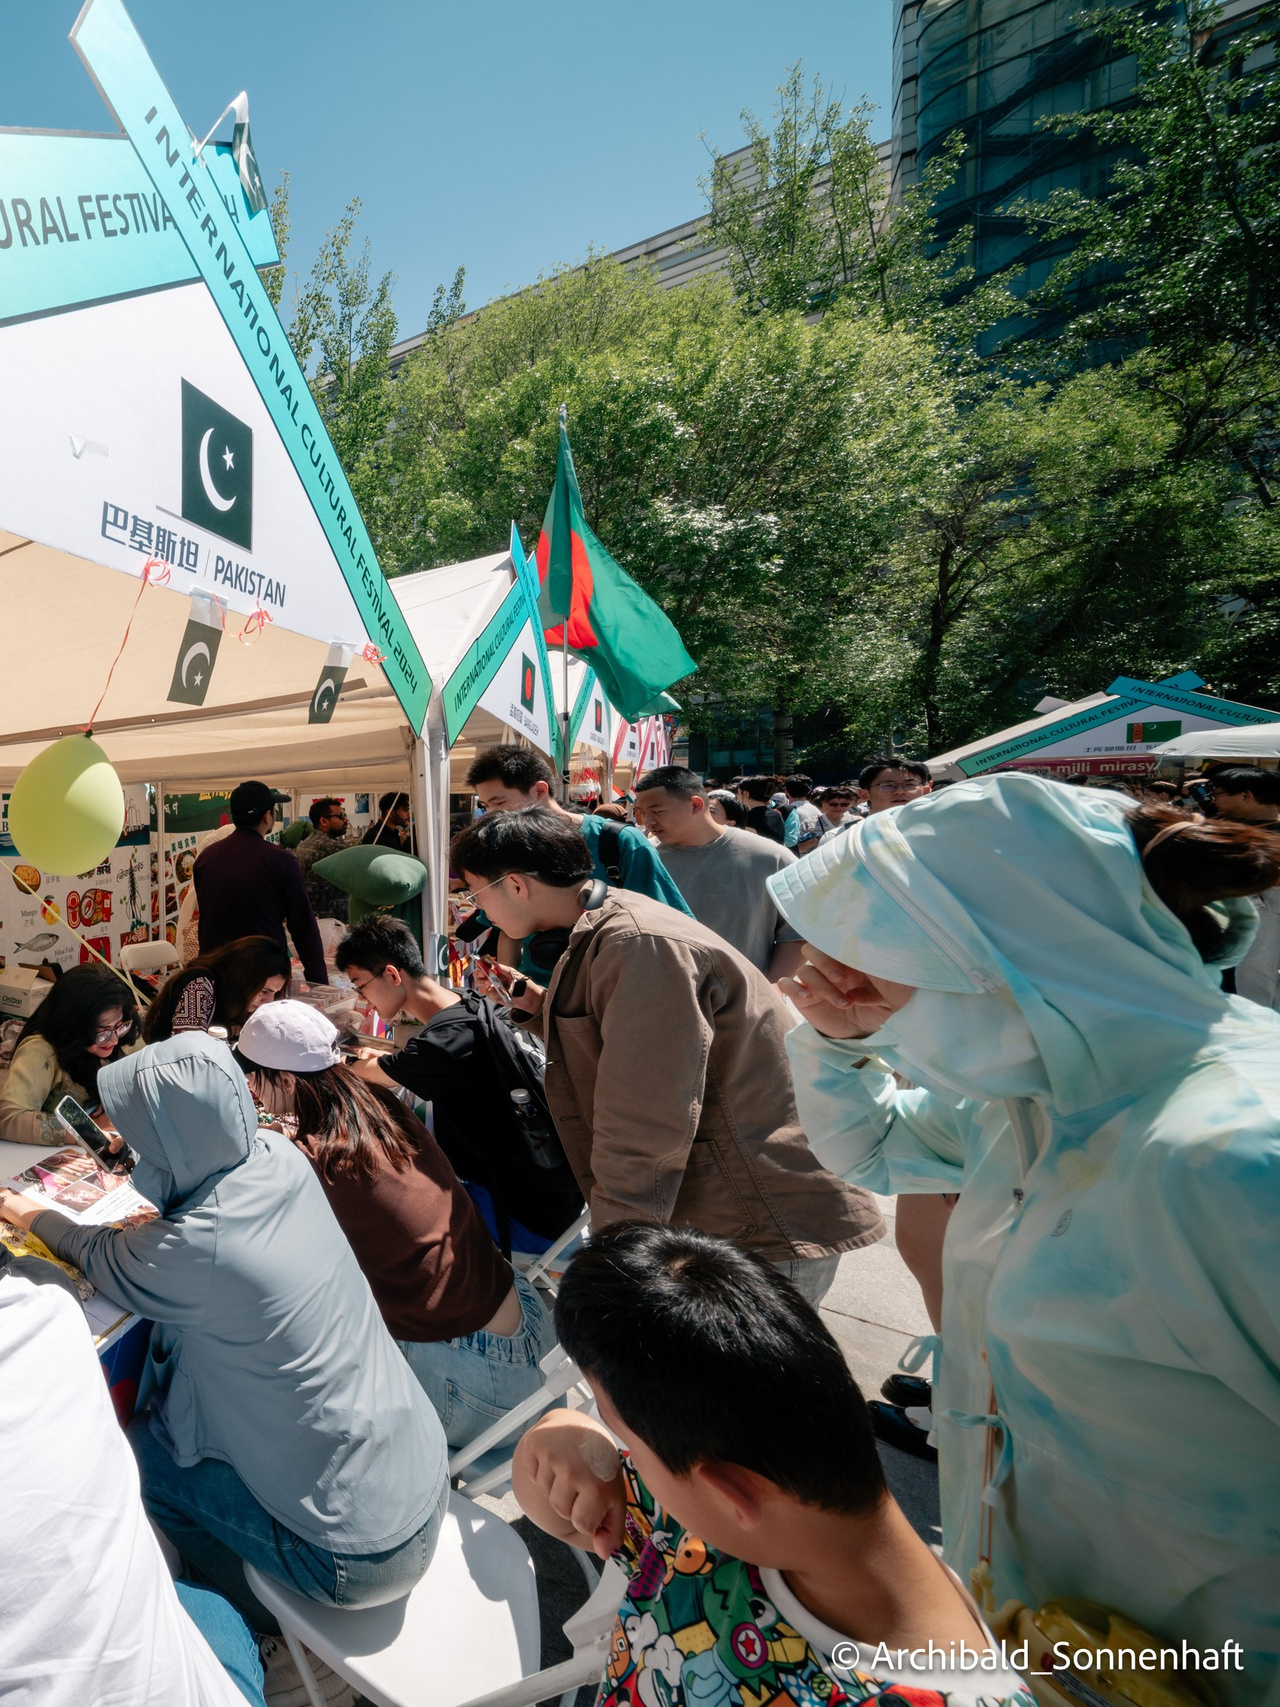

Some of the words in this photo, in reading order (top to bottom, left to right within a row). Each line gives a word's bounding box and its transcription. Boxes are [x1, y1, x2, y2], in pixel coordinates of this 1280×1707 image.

[78, 191, 178, 240] FESTIVA
[144, 106, 298, 427] INTERNATIONAL
[301, 423, 357, 560] CULTURAL
[357, 553, 395, 649] FESTIVAL
[393, 641, 418, 694] 2024
[101, 501, 199, 574] 巴基斯坦
[214, 555, 286, 608] PAKISTAN
[454, 641, 496, 713] INTERNATIONAL
[495, 610, 515, 650] CULTURAL
[975, 734, 1050, 766] INTERNATIONAL
[1050, 714, 1100, 738] CULTURAL
[1100, 699, 1142, 718] FESTIVA
[1130, 686, 1217, 713] INTERNATIONAL
[1219, 707, 1272, 726] CULTURA
[1056, 762, 1090, 774] milli
[1100, 759, 1156, 773] mirasy
[21, 910, 38, 918] Mango
